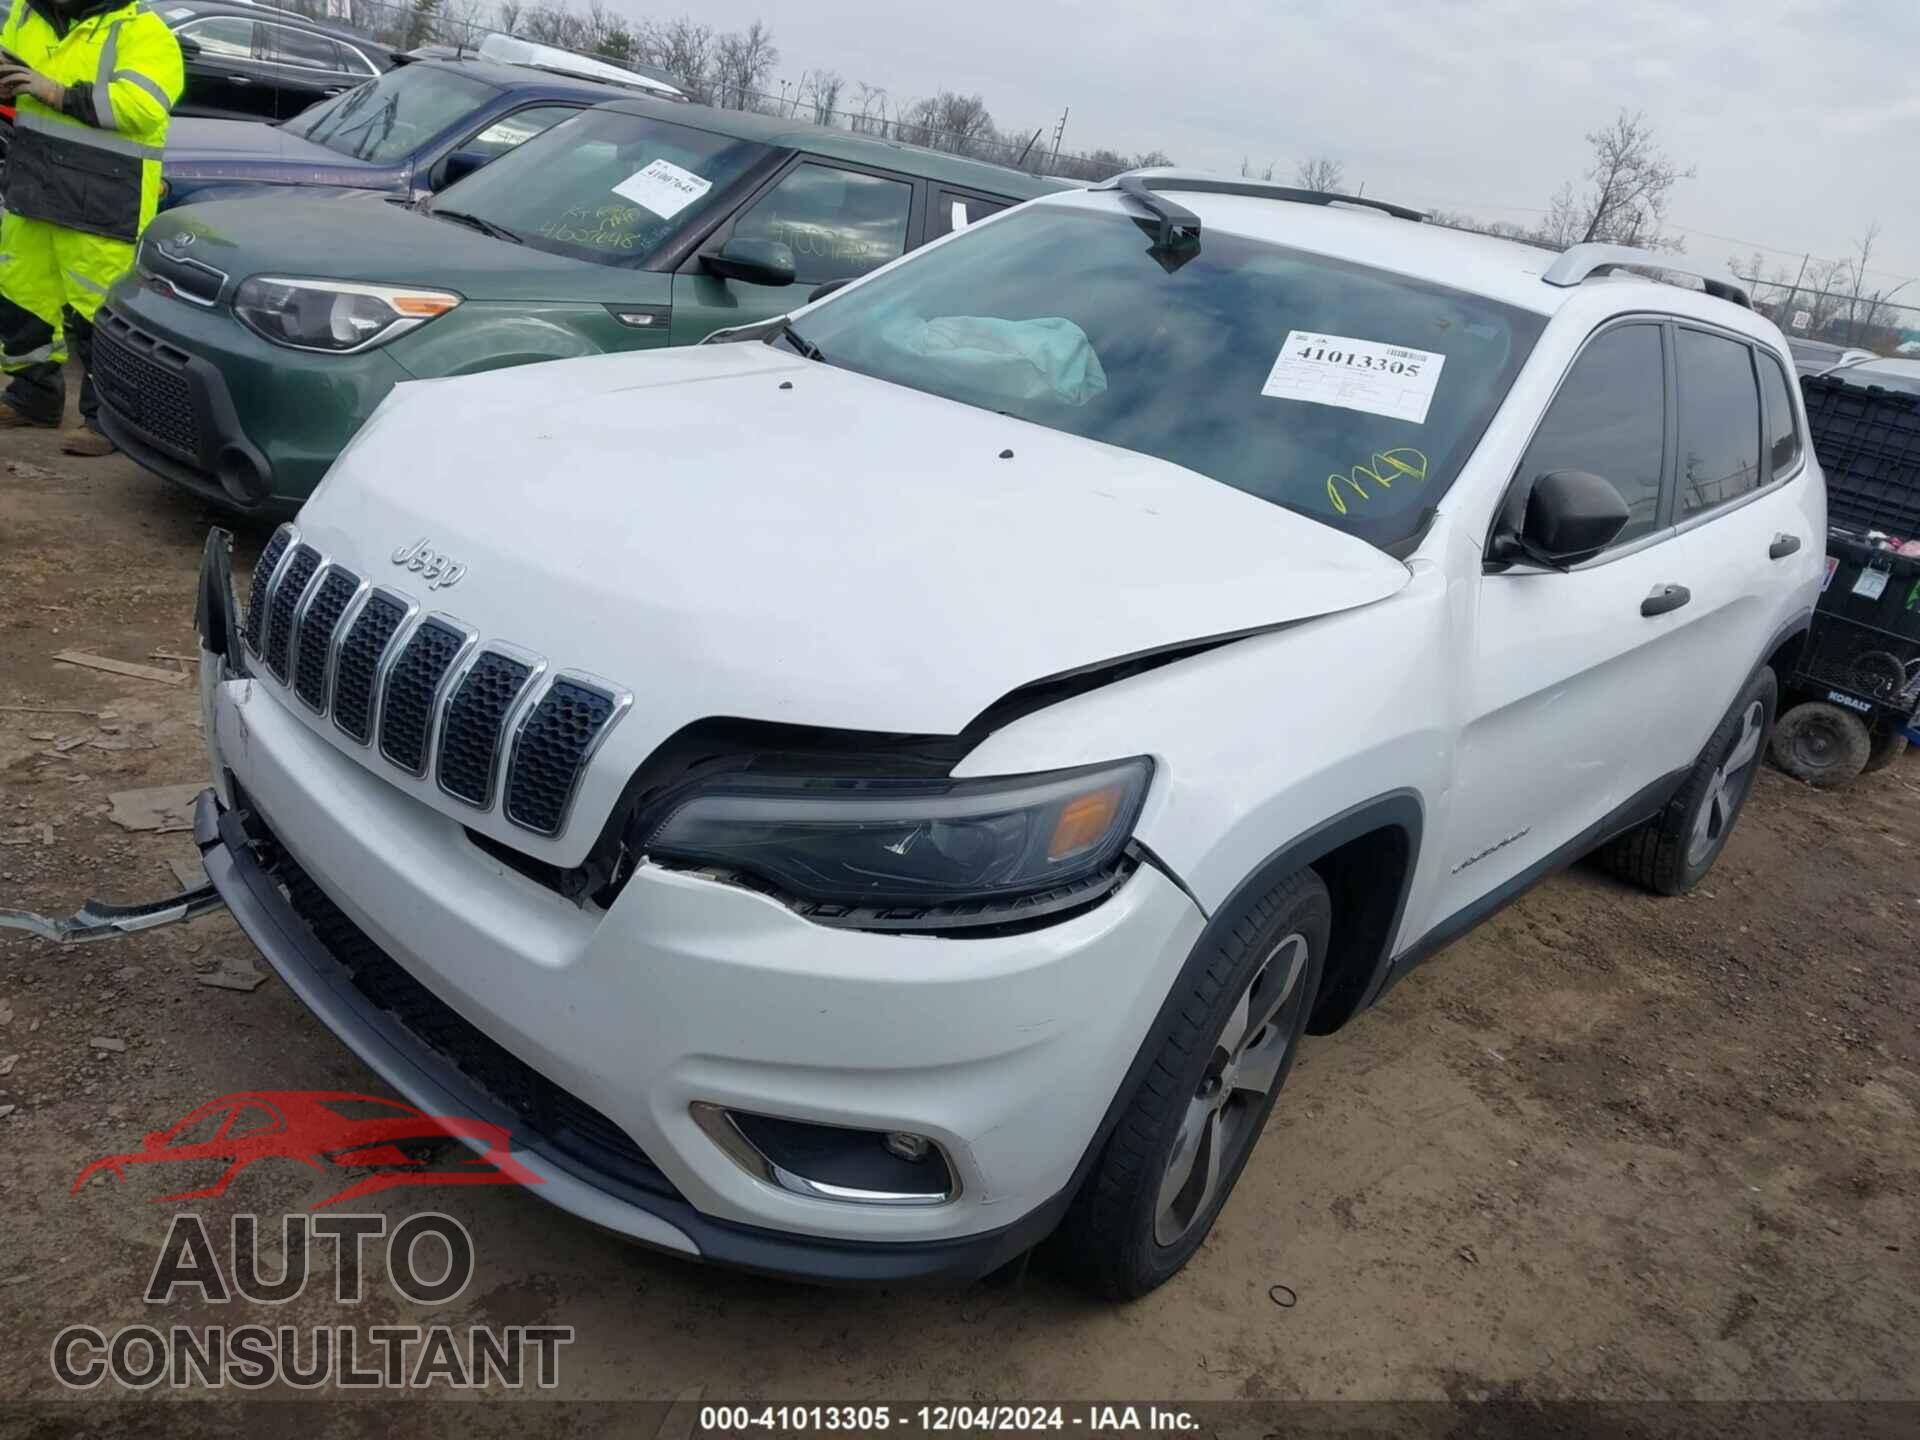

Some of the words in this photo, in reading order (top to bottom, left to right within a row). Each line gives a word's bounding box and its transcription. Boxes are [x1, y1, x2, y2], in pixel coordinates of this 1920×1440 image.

[1297, 346, 1422, 378] 41013305
[391, 536, 468, 592] Jeep
[1828, 690, 1873, 713] KOBALT
